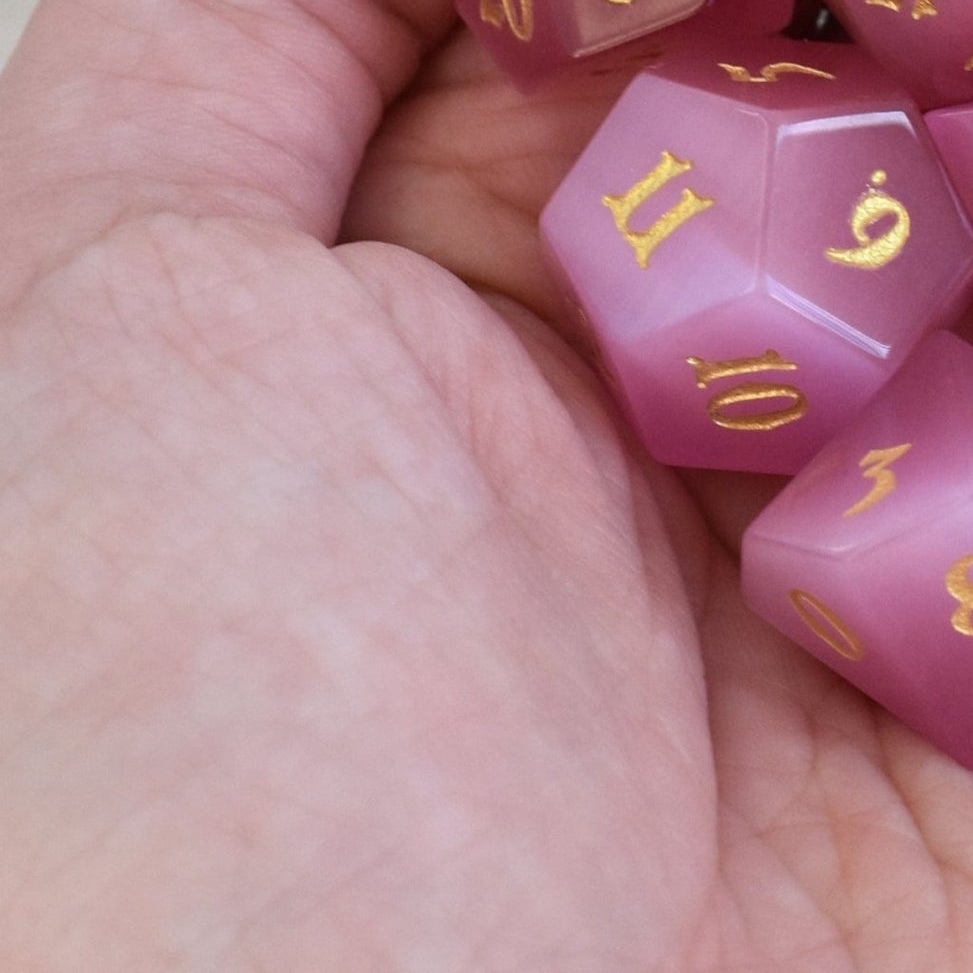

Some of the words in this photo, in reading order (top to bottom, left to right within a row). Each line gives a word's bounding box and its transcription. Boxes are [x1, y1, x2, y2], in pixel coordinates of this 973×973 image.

[602, 150, 715, 270] 11
[686, 350, 808, 431] 10
[842, 443, 912, 518] 3
